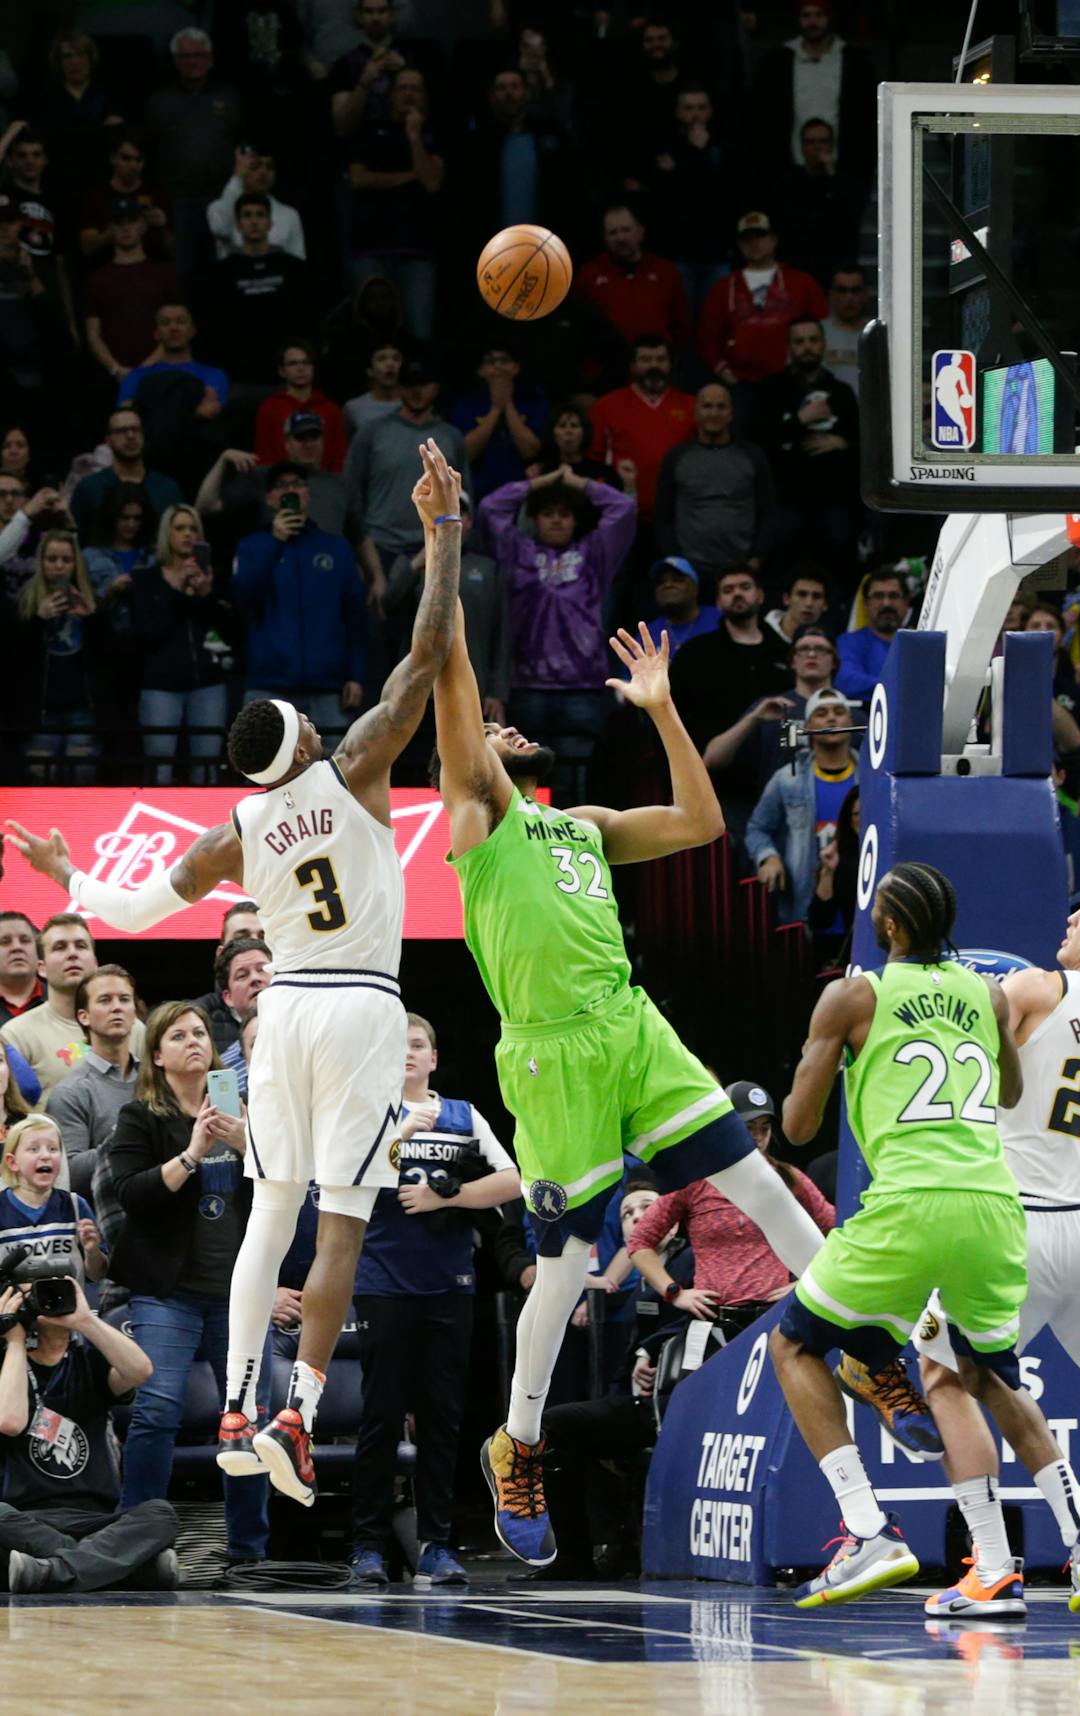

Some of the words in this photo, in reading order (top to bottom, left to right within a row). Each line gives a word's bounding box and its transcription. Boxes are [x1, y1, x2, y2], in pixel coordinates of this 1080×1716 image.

[937, 426, 960, 442] NBA
[910, 466, 976, 481] SPALDING
[264, 808, 333, 856] CRAIG
[294, 857, 347, 932] 3
[548, 845, 609, 900] 32
[893, 992, 980, 1033] WIGGINS
[893, 1039, 998, 1125] 22
[696, 1431, 767, 1493] TARGET
[689, 1497, 754, 1563] CENTER
